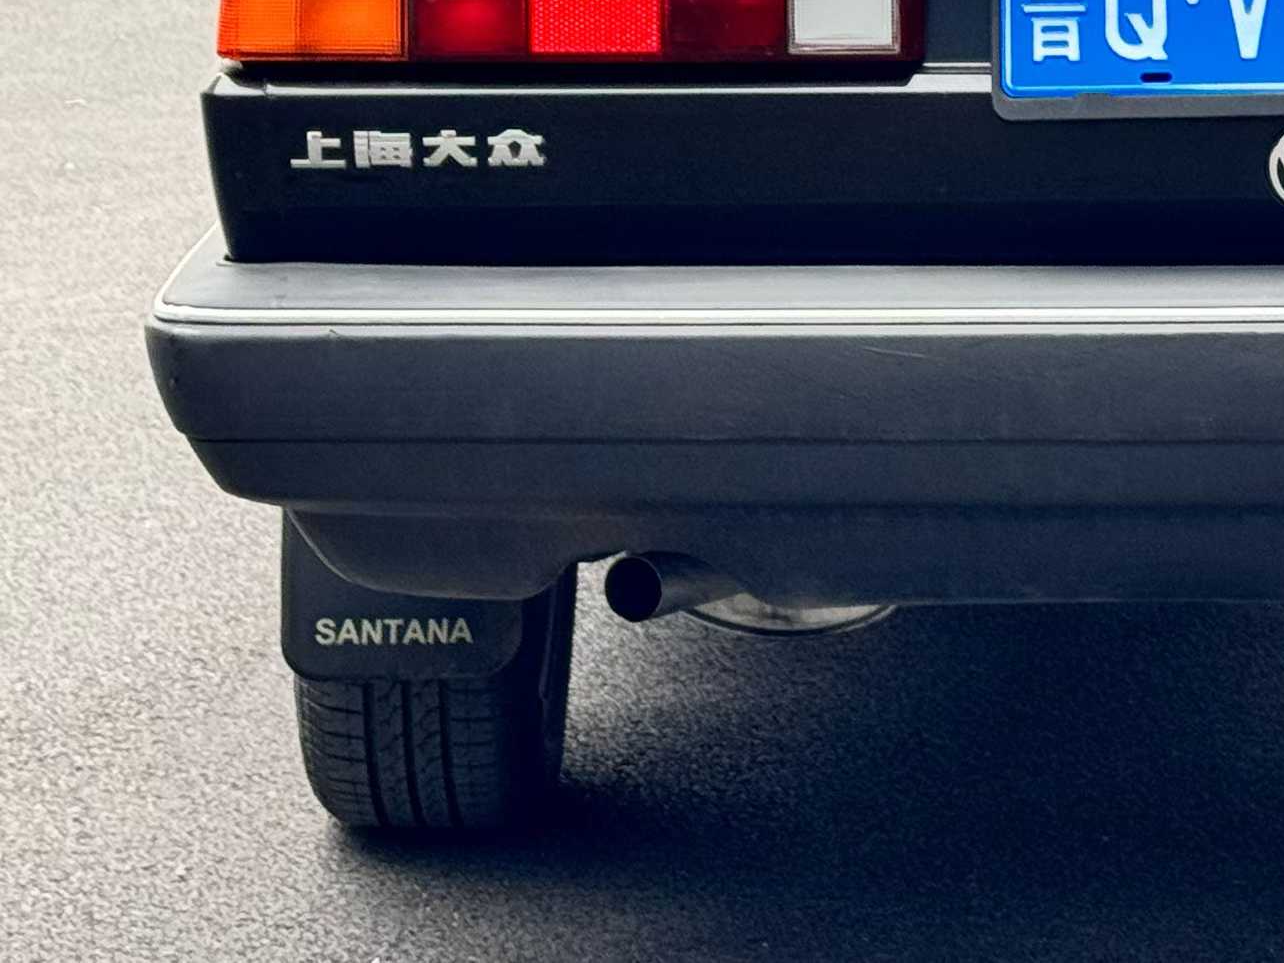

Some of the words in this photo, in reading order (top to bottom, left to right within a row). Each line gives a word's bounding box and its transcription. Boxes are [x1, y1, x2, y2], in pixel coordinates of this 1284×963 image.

[289, 128, 547, 169] 上海大众
[314, 617, 474, 645] SANTANA
